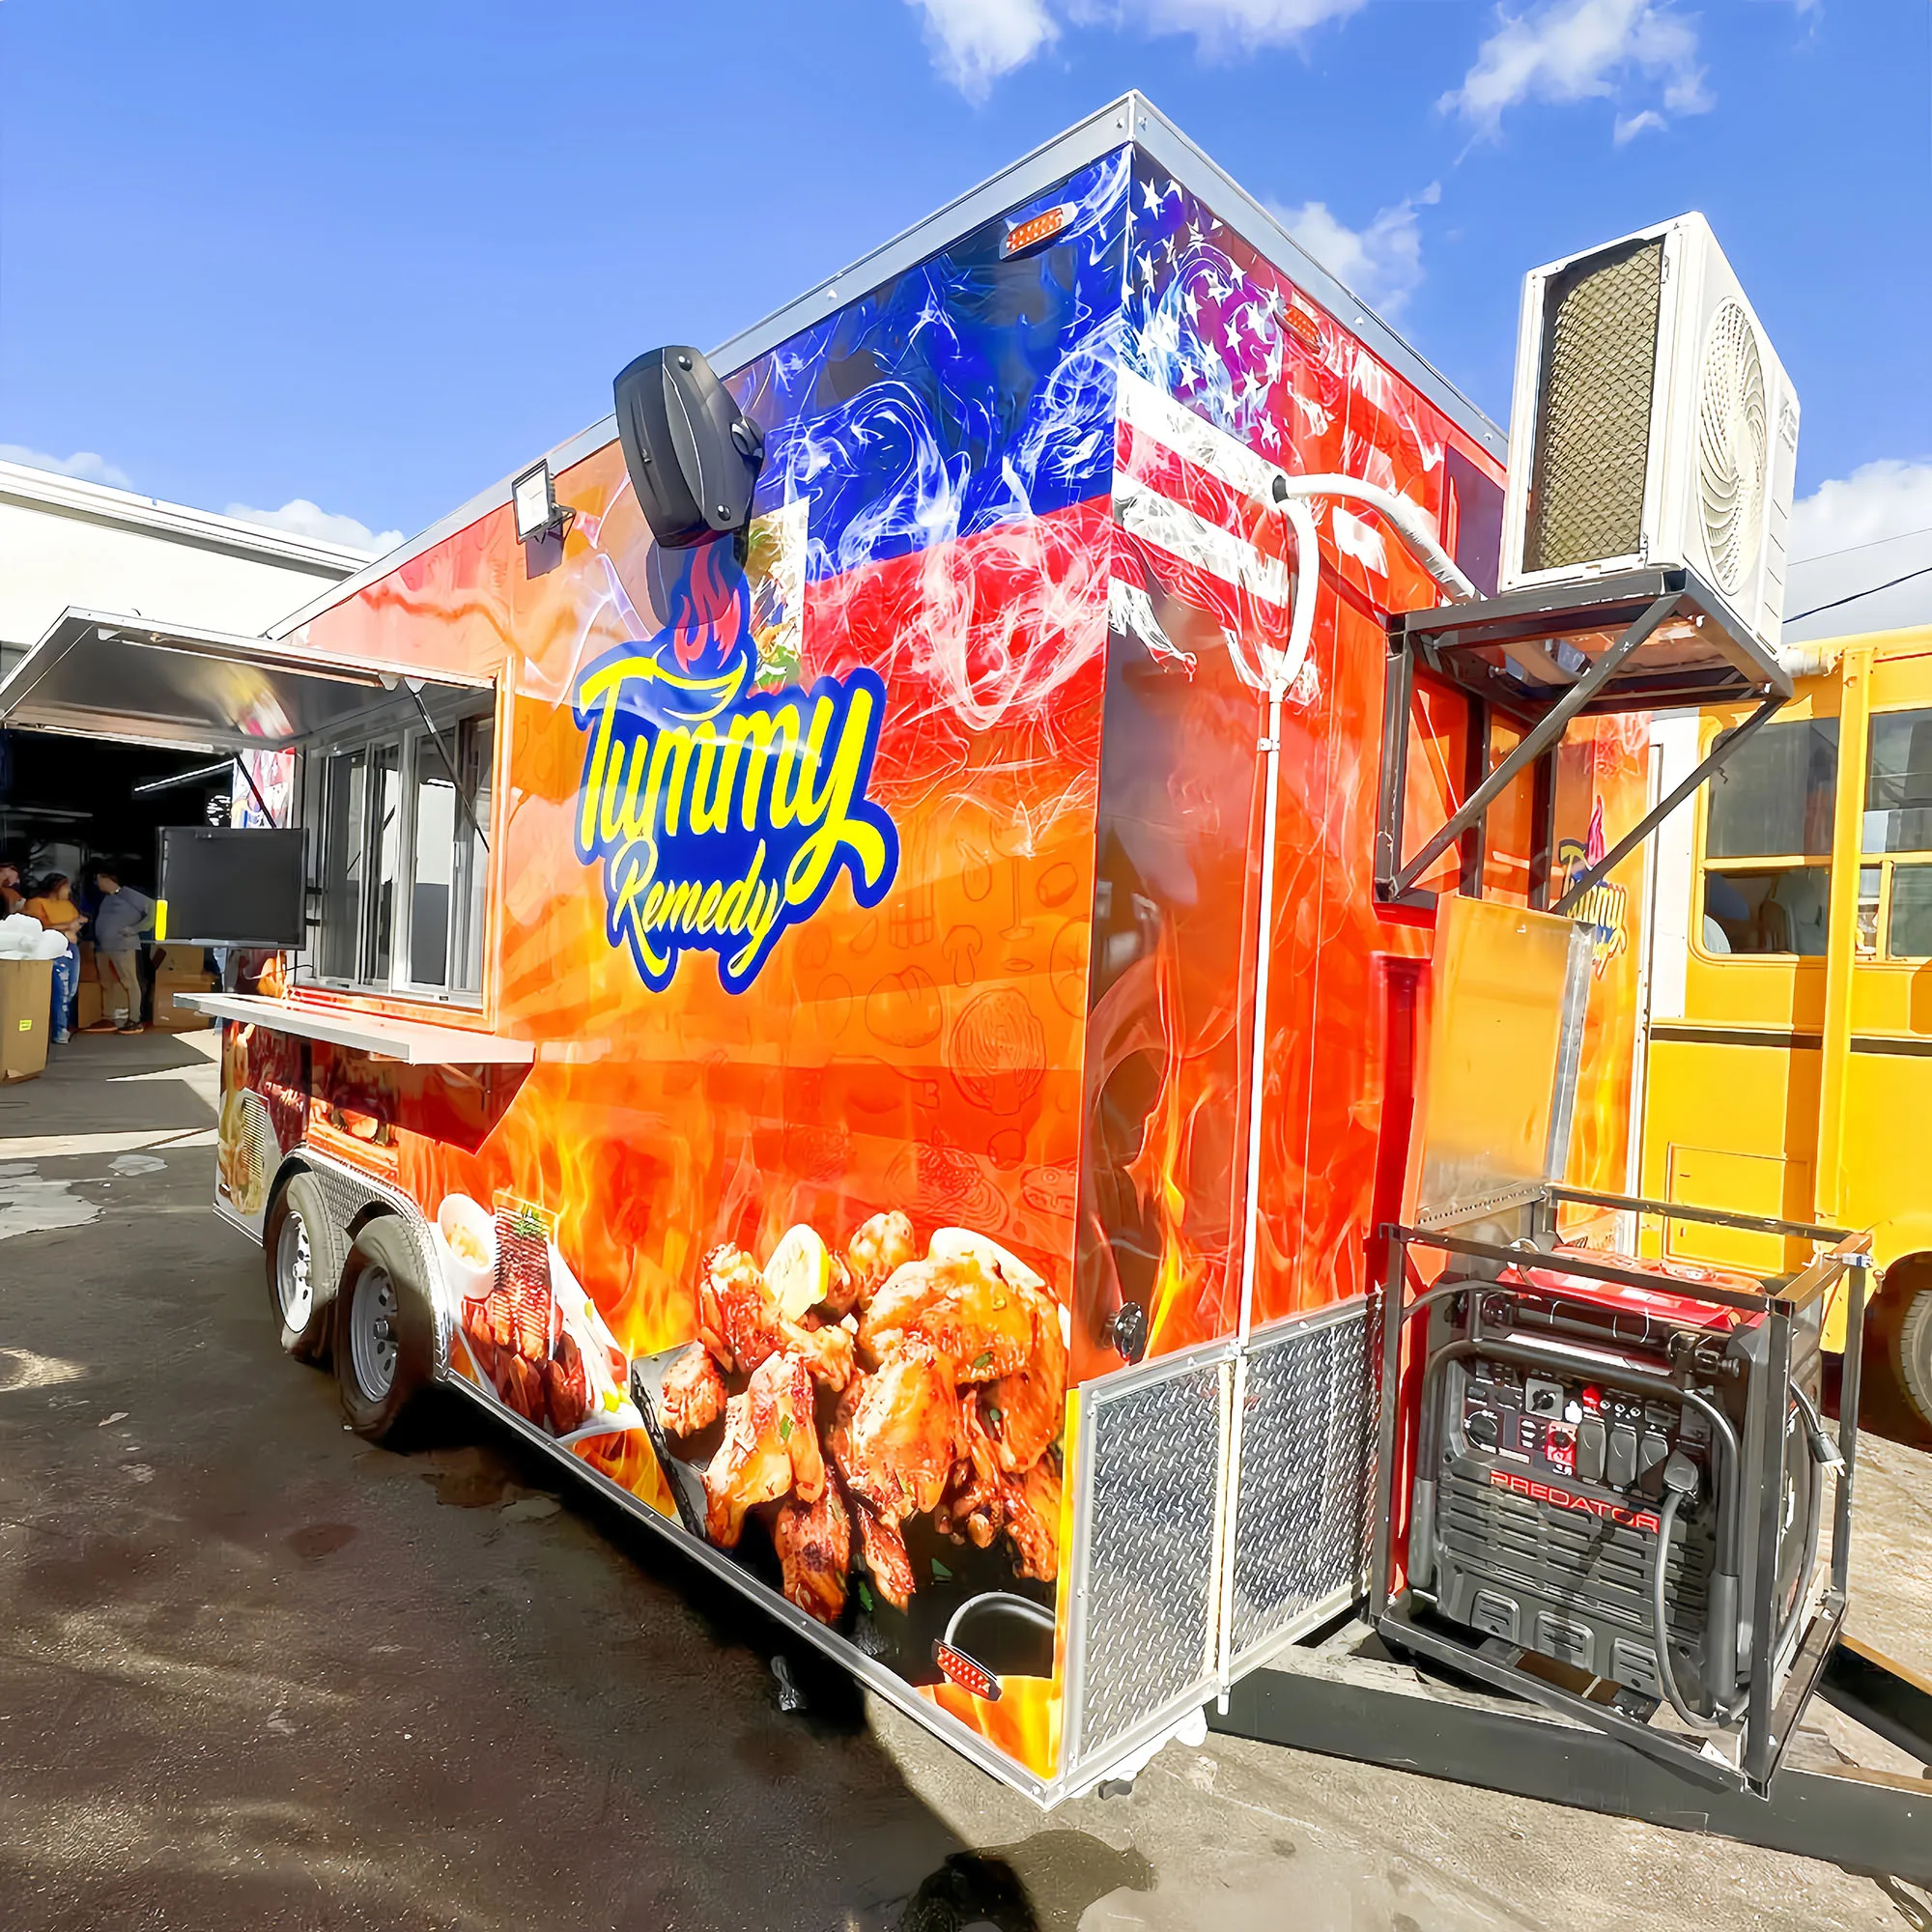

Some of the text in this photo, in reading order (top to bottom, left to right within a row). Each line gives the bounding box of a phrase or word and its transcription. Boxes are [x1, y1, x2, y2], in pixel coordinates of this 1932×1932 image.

[580, 645, 886, 906] Tummy
[611, 838, 786, 978] Remedy
[1490, 1469, 1660, 1534] PREDATOR
